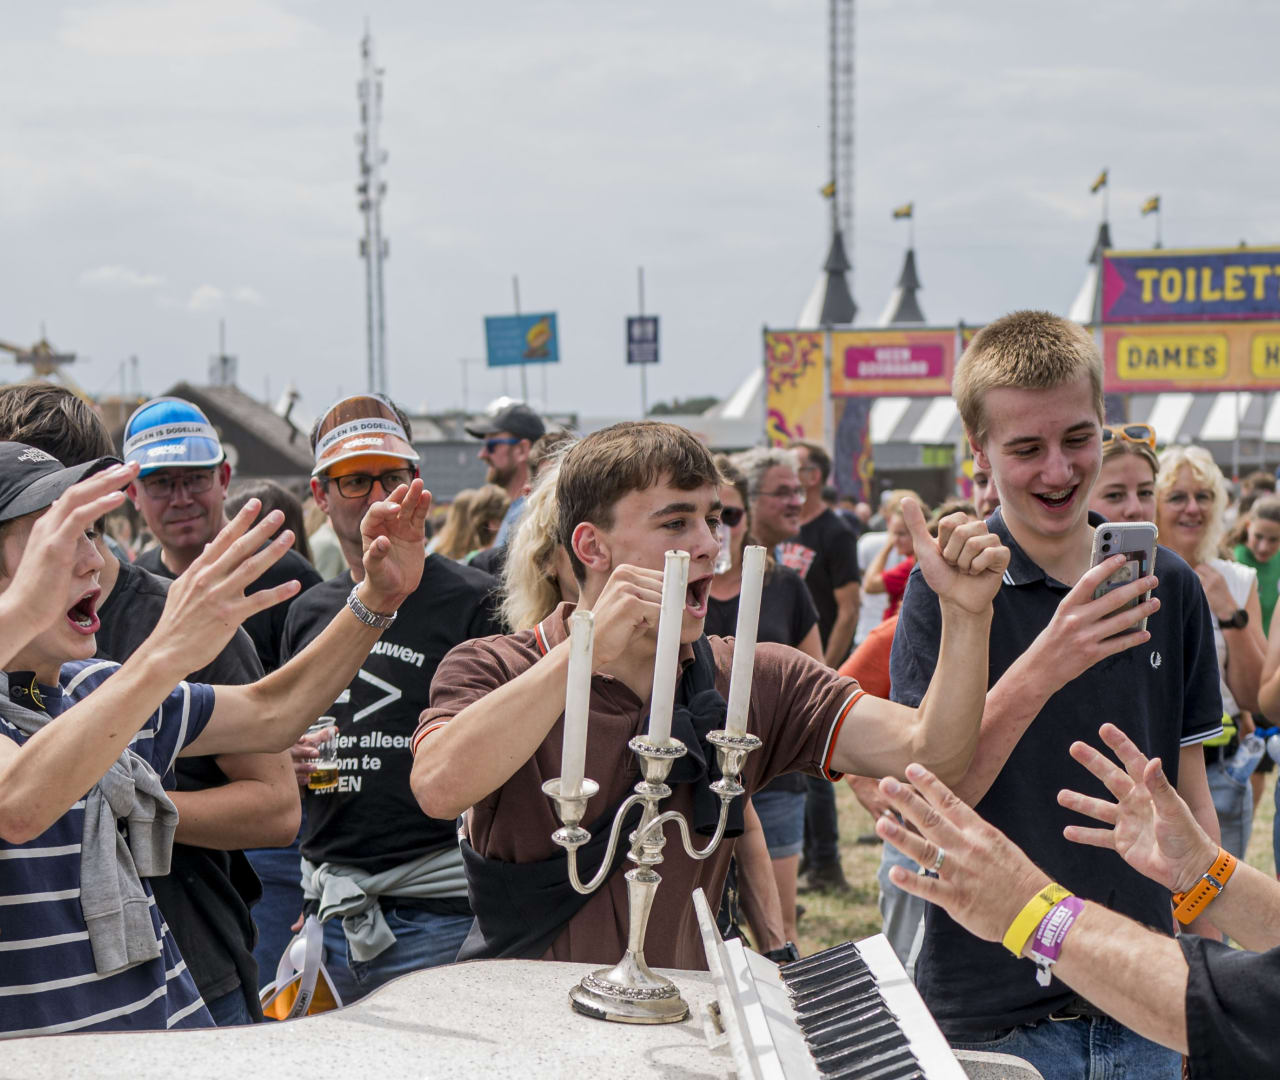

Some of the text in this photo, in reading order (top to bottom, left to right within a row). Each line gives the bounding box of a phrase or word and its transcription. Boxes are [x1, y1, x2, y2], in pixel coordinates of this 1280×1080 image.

[1127, 345, 1217, 369] DAMES
[362, 754, 381, 770] te
[1041, 905, 1071, 947] ARTIEST
